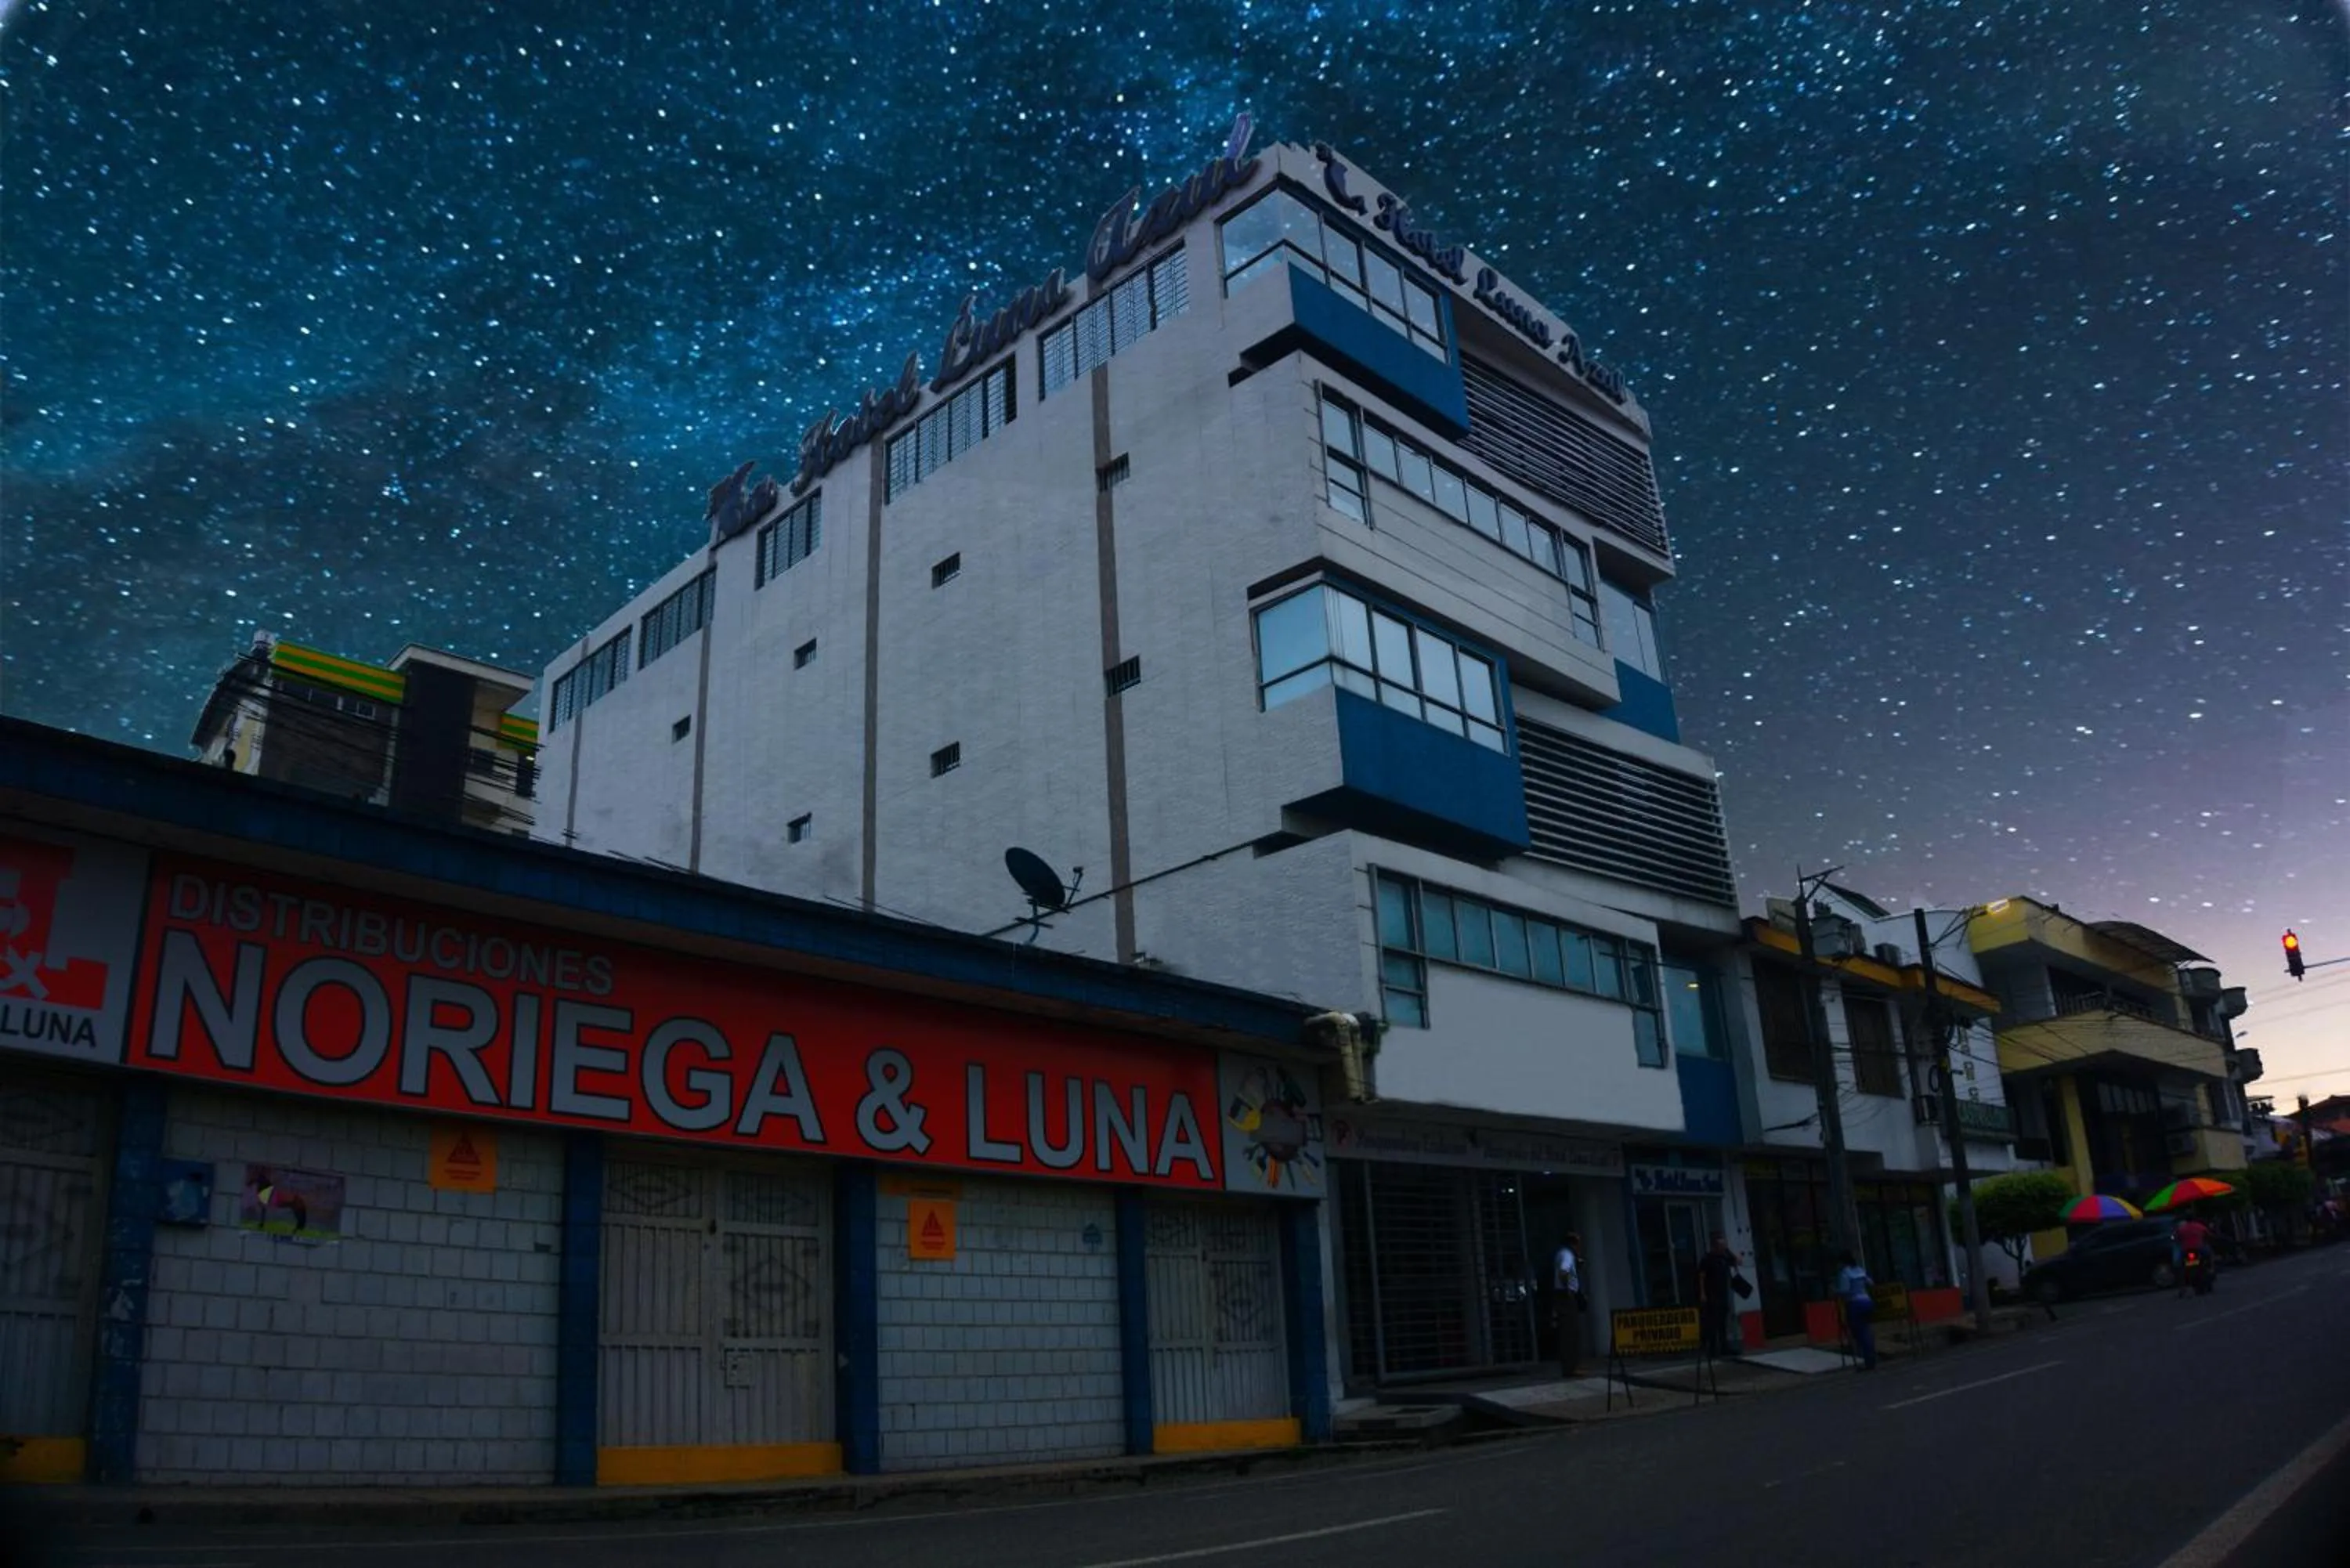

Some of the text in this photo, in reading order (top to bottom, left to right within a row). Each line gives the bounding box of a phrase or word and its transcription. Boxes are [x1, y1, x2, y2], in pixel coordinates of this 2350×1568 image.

[170, 873, 614, 995] DISTRIBUCIONES
[0, 1003, 96, 1048] LUNA
[147, 927, 1216, 1181] NORIEGA & LUNA
